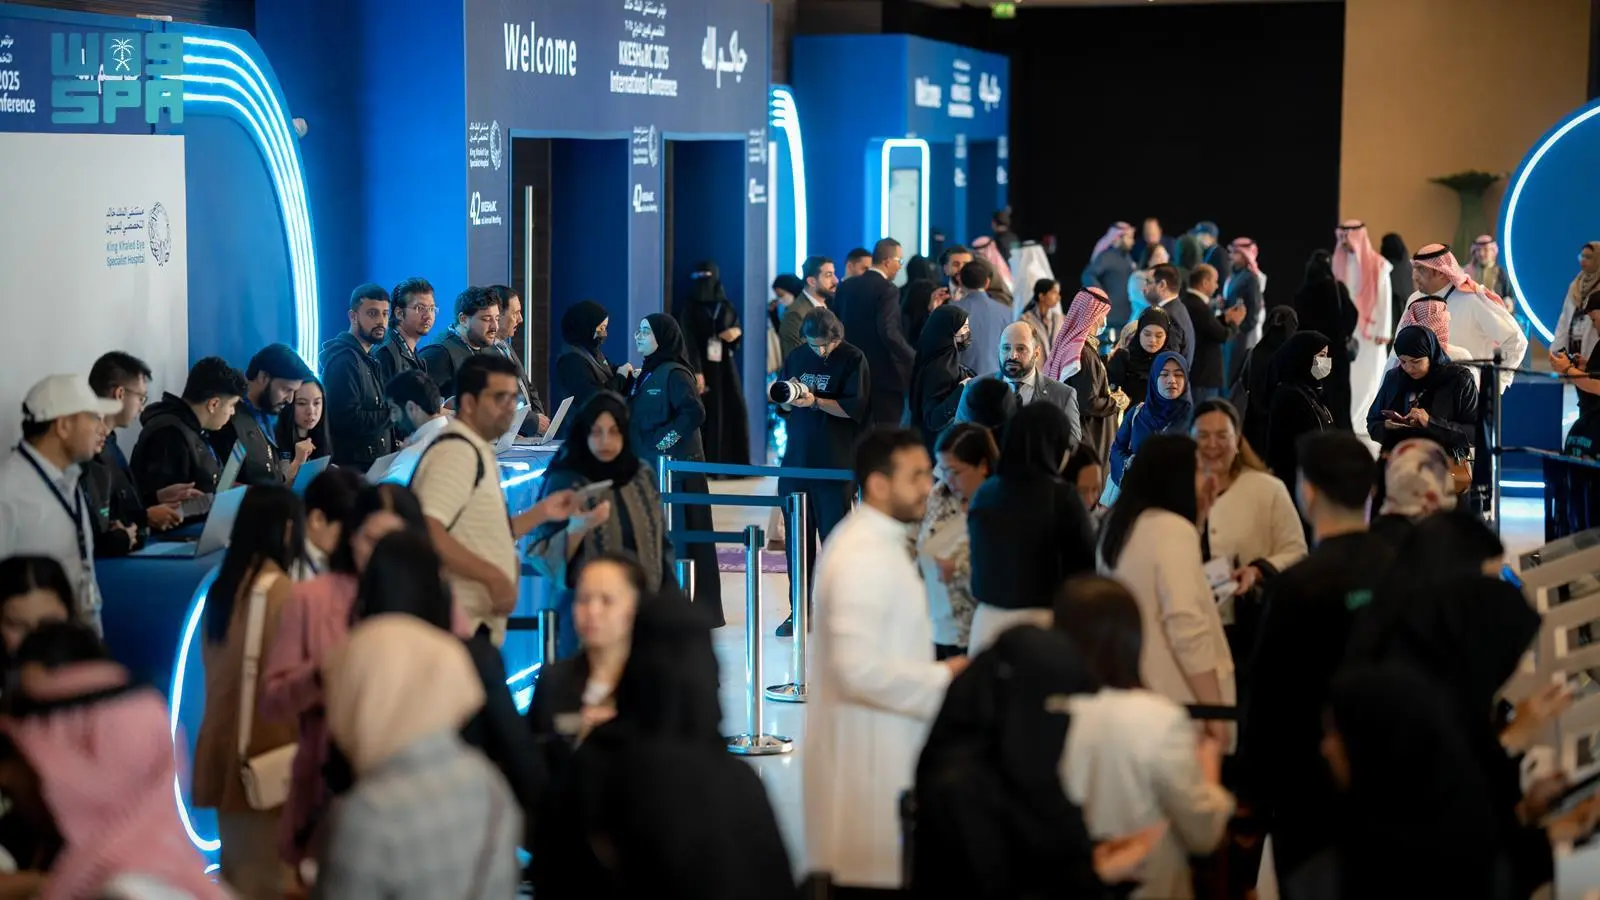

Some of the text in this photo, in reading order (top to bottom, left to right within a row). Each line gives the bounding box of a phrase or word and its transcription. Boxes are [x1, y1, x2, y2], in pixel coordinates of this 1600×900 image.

[503, 21, 577, 76] Welcome
[610, 69, 678, 97] International Conference
[0, 92, 36, 113] nference
[470, 191, 480, 226] 42
[106, 239, 145, 254] King Khaled Eye
[106, 253, 145, 268] Specialist Hospital
